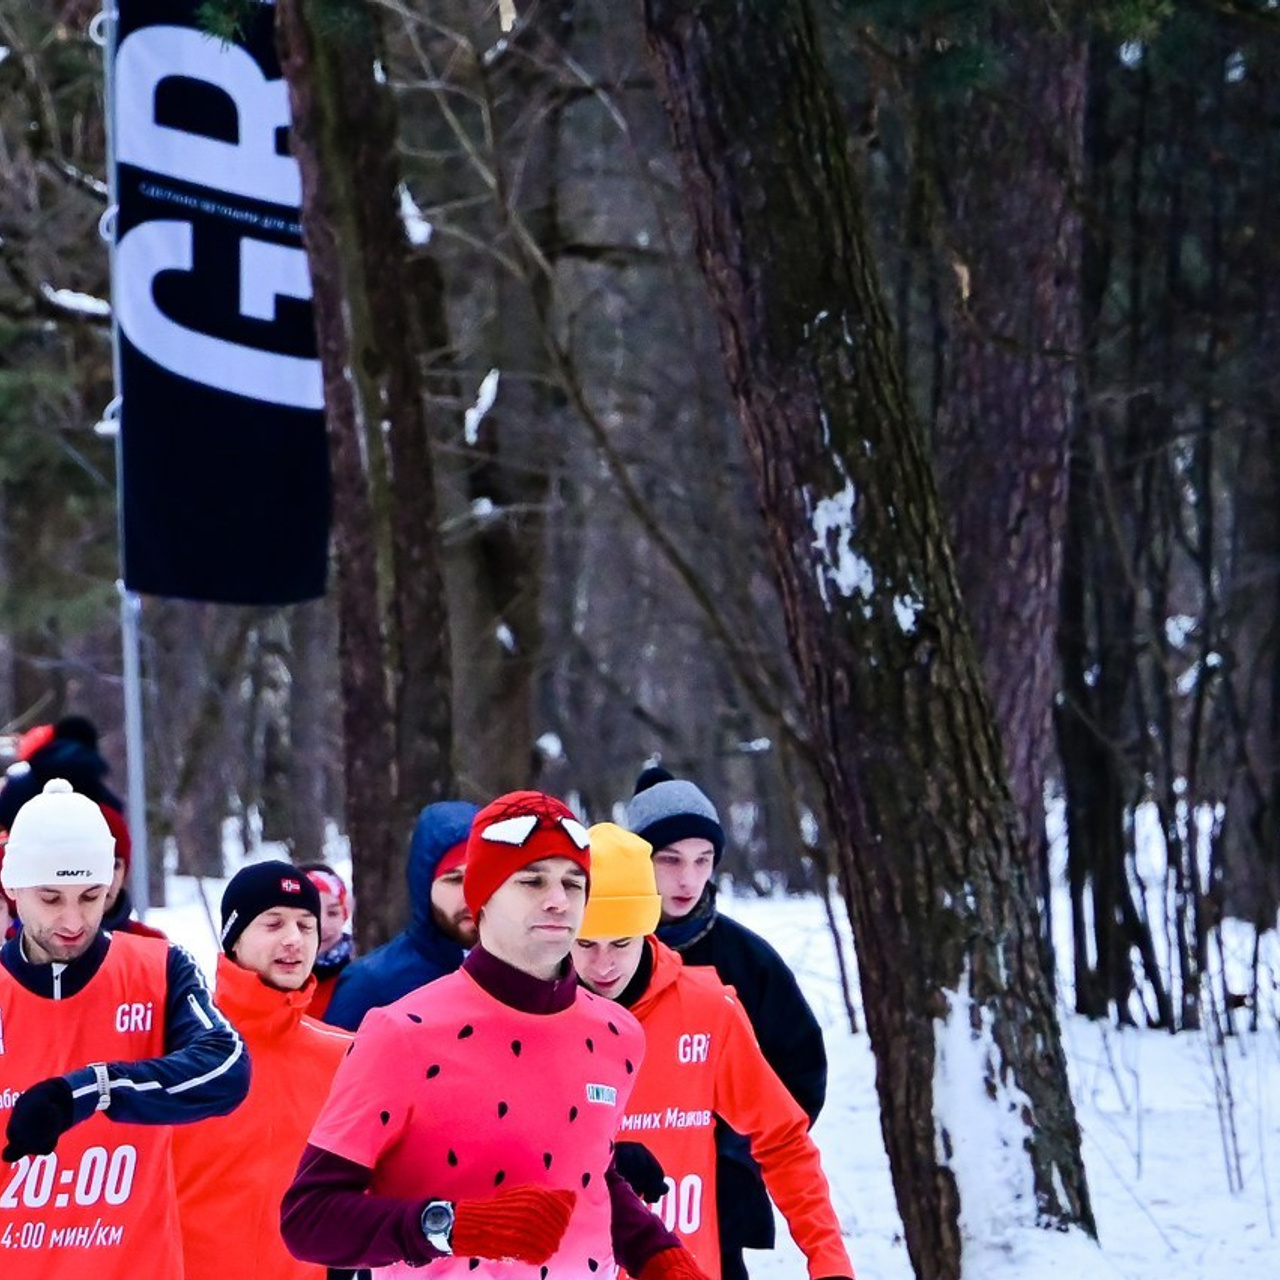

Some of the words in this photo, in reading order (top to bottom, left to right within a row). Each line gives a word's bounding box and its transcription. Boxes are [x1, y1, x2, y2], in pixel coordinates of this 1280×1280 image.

[115, 1002, 153, 1033] GRi
[678, 1033, 711, 1064] GRi
[621, 1112, 662, 1131] мних
[0, 1221, 46, 1249] 4:00
[48, 1217, 124, 1249] мин/км
